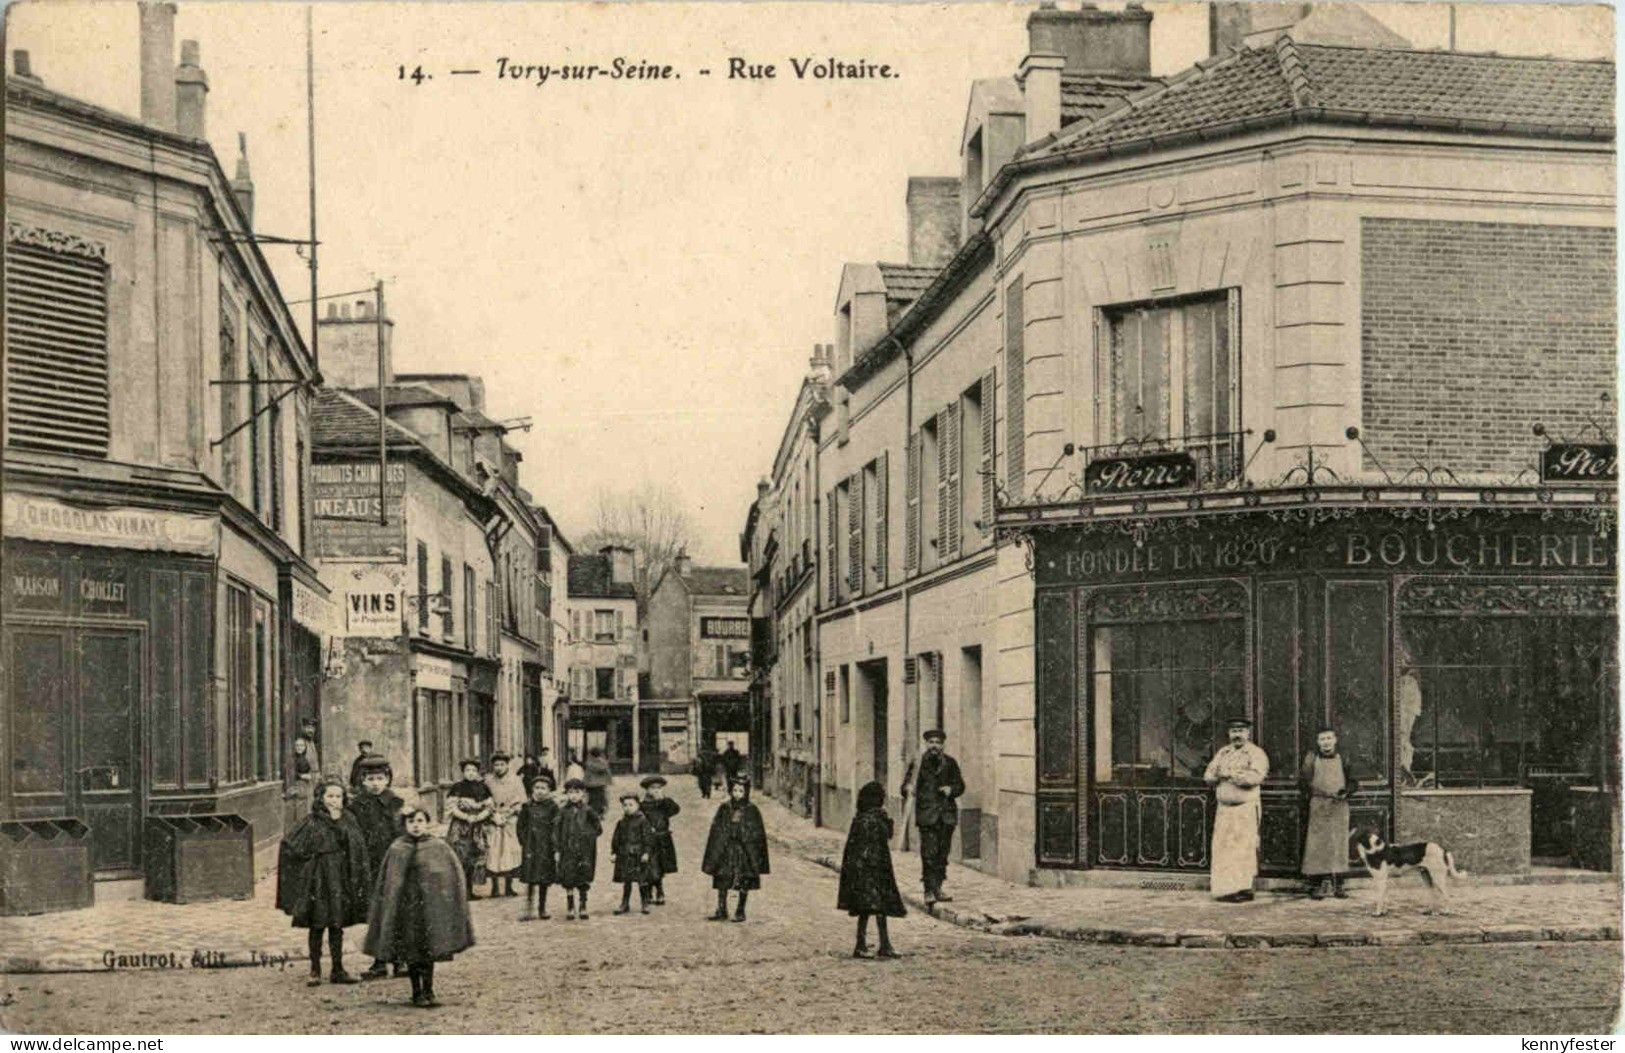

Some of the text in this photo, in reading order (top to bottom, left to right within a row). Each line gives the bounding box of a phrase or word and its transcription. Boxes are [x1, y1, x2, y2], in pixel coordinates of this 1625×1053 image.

[1089, 461, 1184, 489] Pierre
[1171, 545, 1202, 570] EN
[1214, 539, 1278, 567] 1820
[1345, 533, 1609, 567] BOUCHERIE
[350, 593, 397, 613] VINS
